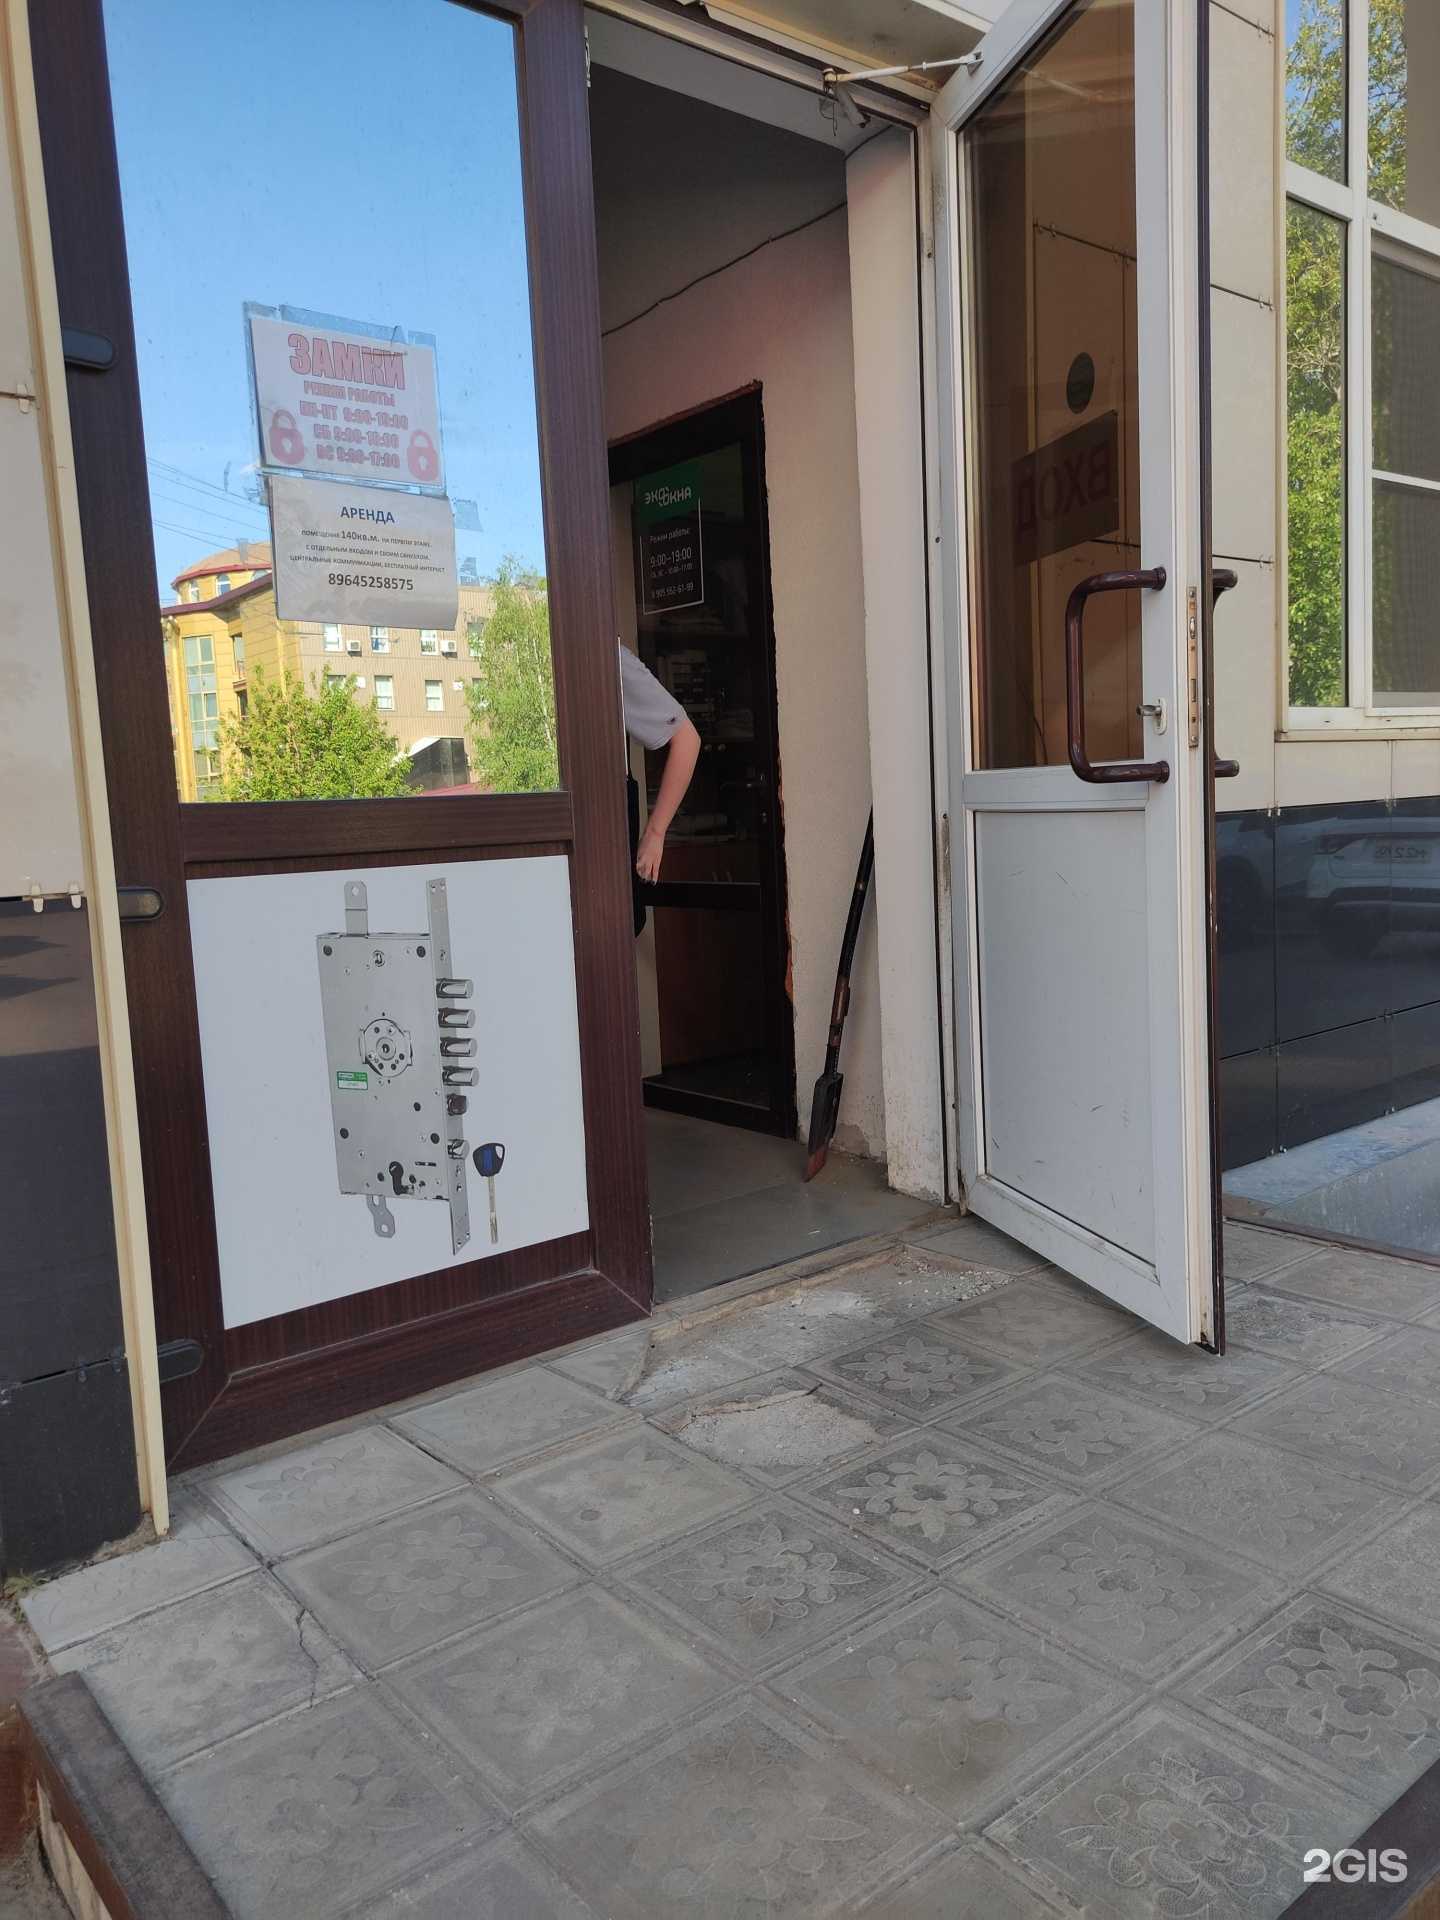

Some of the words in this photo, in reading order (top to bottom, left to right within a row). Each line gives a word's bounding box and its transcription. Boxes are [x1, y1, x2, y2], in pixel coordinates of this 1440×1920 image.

[288, 333, 405, 390] ЗАМКИ
[340, 506, 396, 525] АРЕНДА
[341, 531, 380, 542] 140кв.м.
[328, 572, 414, 591] 89645258575
